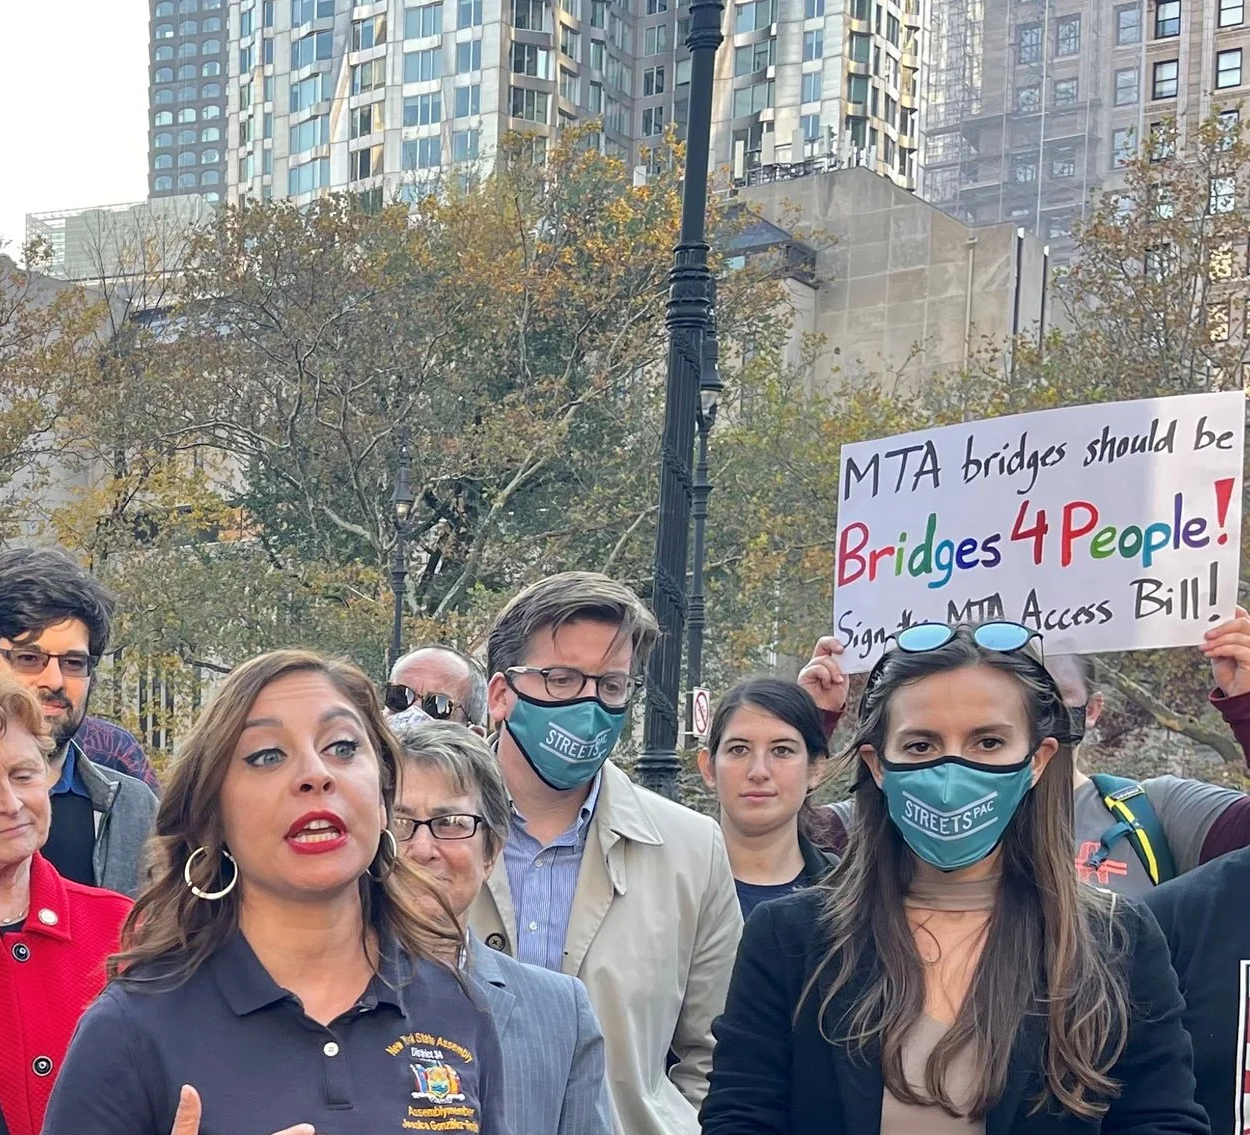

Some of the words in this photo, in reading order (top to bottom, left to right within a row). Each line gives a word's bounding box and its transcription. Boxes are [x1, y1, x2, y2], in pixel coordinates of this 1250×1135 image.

[843, 439, 943, 501] MTA
[961, 431, 1068, 496] bridges
[1082, 417, 1179, 468] should
[1192, 415, 1234, 452] be
[836, 511, 1002, 590] Bridges
[1010, 499, 1049, 567] 4
[1060, 477, 1236, 569] People!
[837, 609, 886, 660] Sign
[1021, 587, 1114, 632] Access
[1129, 561, 1221, 623] Bill!
[545, 729, 600, 759] STREETS
[904, 799, 973, 835] STREETS
[973, 800, 995, 820] PAC
